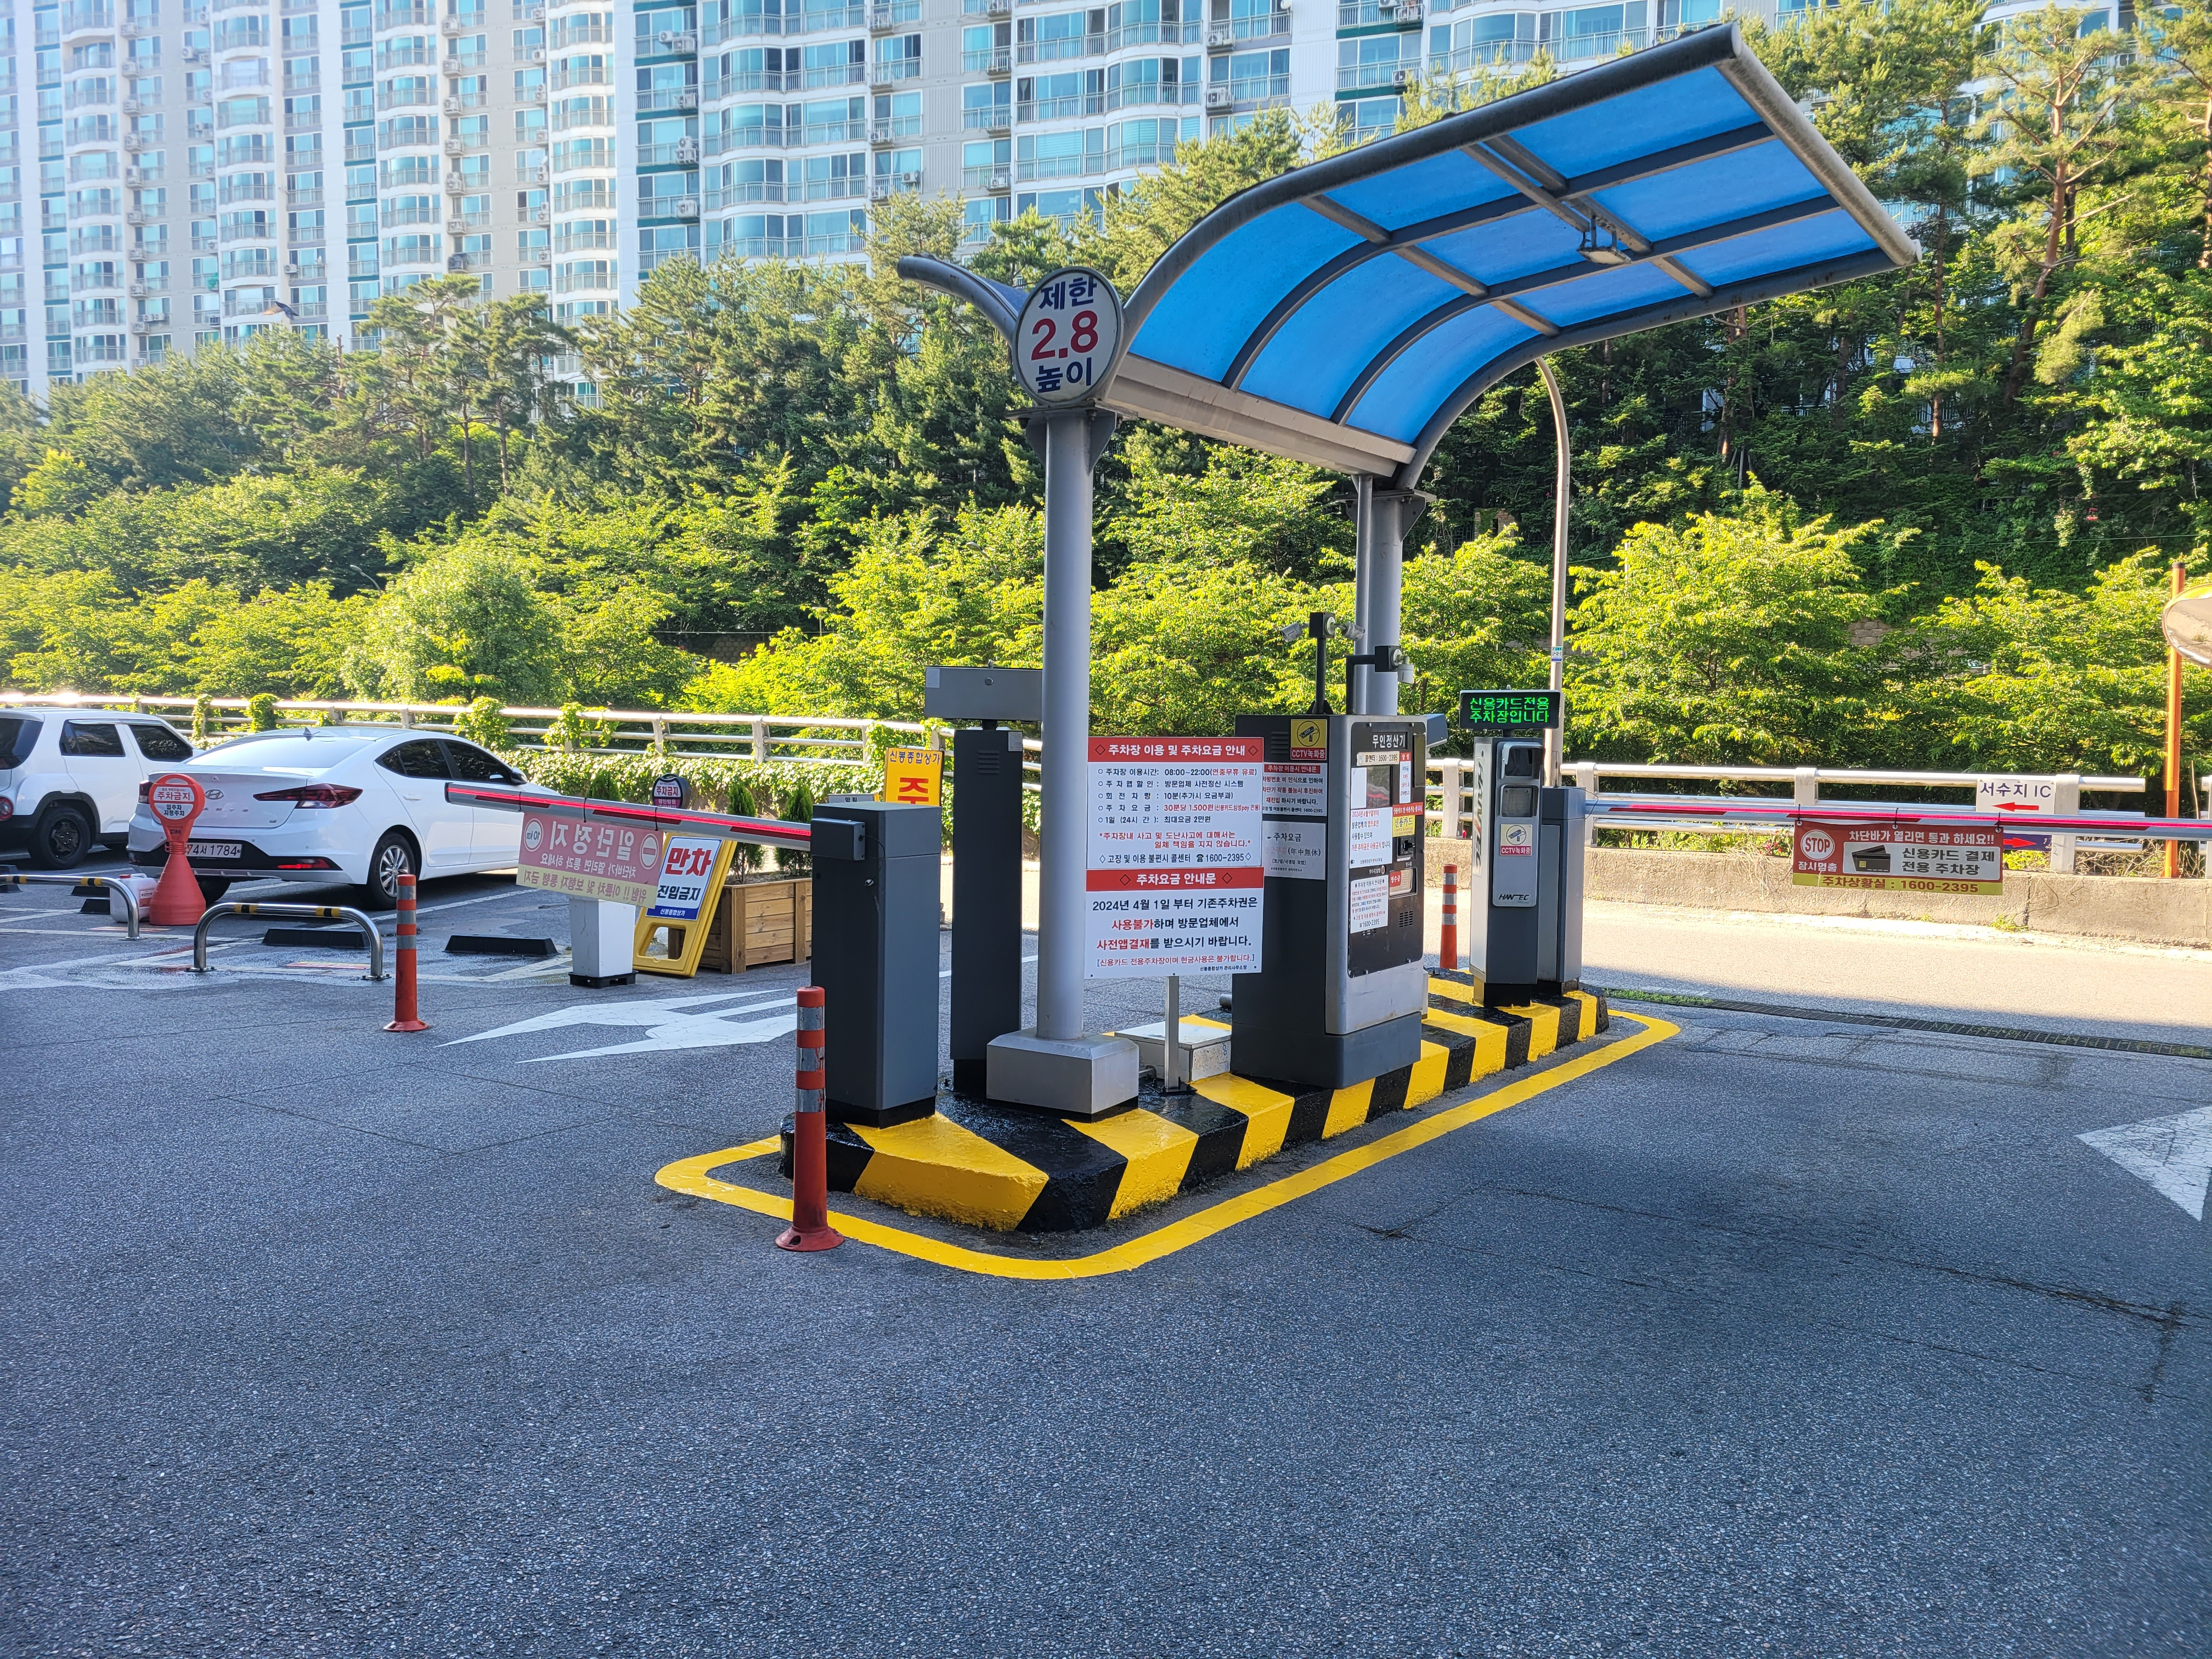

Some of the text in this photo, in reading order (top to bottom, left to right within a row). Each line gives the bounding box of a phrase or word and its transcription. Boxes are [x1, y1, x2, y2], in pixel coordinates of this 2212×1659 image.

[1039, 276, 1097, 310] 제한
[1031, 310, 1098, 361] 2.8
[1035, 357, 1092, 394] 높이
[1470, 697, 1549, 710] 신용카드전용
[1470, 710, 1549, 723] 주차장입니다
[1372, 734, 1406, 749] 무인정산기
[1108, 744, 1245, 756] 주차장 이용 및 주차요금 안내
[1292, 749, 1325, 759] CCTV녹화중
[889, 751, 940, 765] 신봉종합상가
[157, 791, 190, 801] 주차금지
[656, 786, 678, 796] 주차금지
[1979, 782, 2052, 798] 서수지 IC
[1394, 817, 1413, 828] 신용카드
[1165, 831, 1203, 839] 도난사고에
[1273, 832, 1302, 842] 주차요금
[1849, 830, 1994, 845] 차단바가 열리면 통과 하세요!!
[1154, 840, 1169, 849] 일체
[1501, 847, 1531, 855] CCTV녹화중
[1804, 836, 1831, 854] STOP
[1107, 854, 1244, 864] 고장 및 이용 불편시 콜센터 1600-2395
[1901, 847, 1995, 862] 신용카드 결제
[664, 847, 712, 877] 만차
[1798, 861, 1838, 873] 잠시멈춤
[1901, 860, 1980, 876] 전용 주차장
[1136, 873, 1216, 885] 주차요금 안내문
[1822, 876, 1886, 890] 주차상황실
[1900, 880, 1979, 894] 1600-2395
[657, 885, 701, 902] 진입금지
[1092, 897, 1258, 911] 2024년 4월 1일 부터 기존주차권은
[1111, 917, 1239, 930] 사용불가하며 방문업체에서
[1097, 935, 1251, 950] 사전앱결재를 받으시기 바랍니다.
[1097, 954, 1255, 968] [신용카드 전용주차장이며 현금사용은 불가합니다.]
